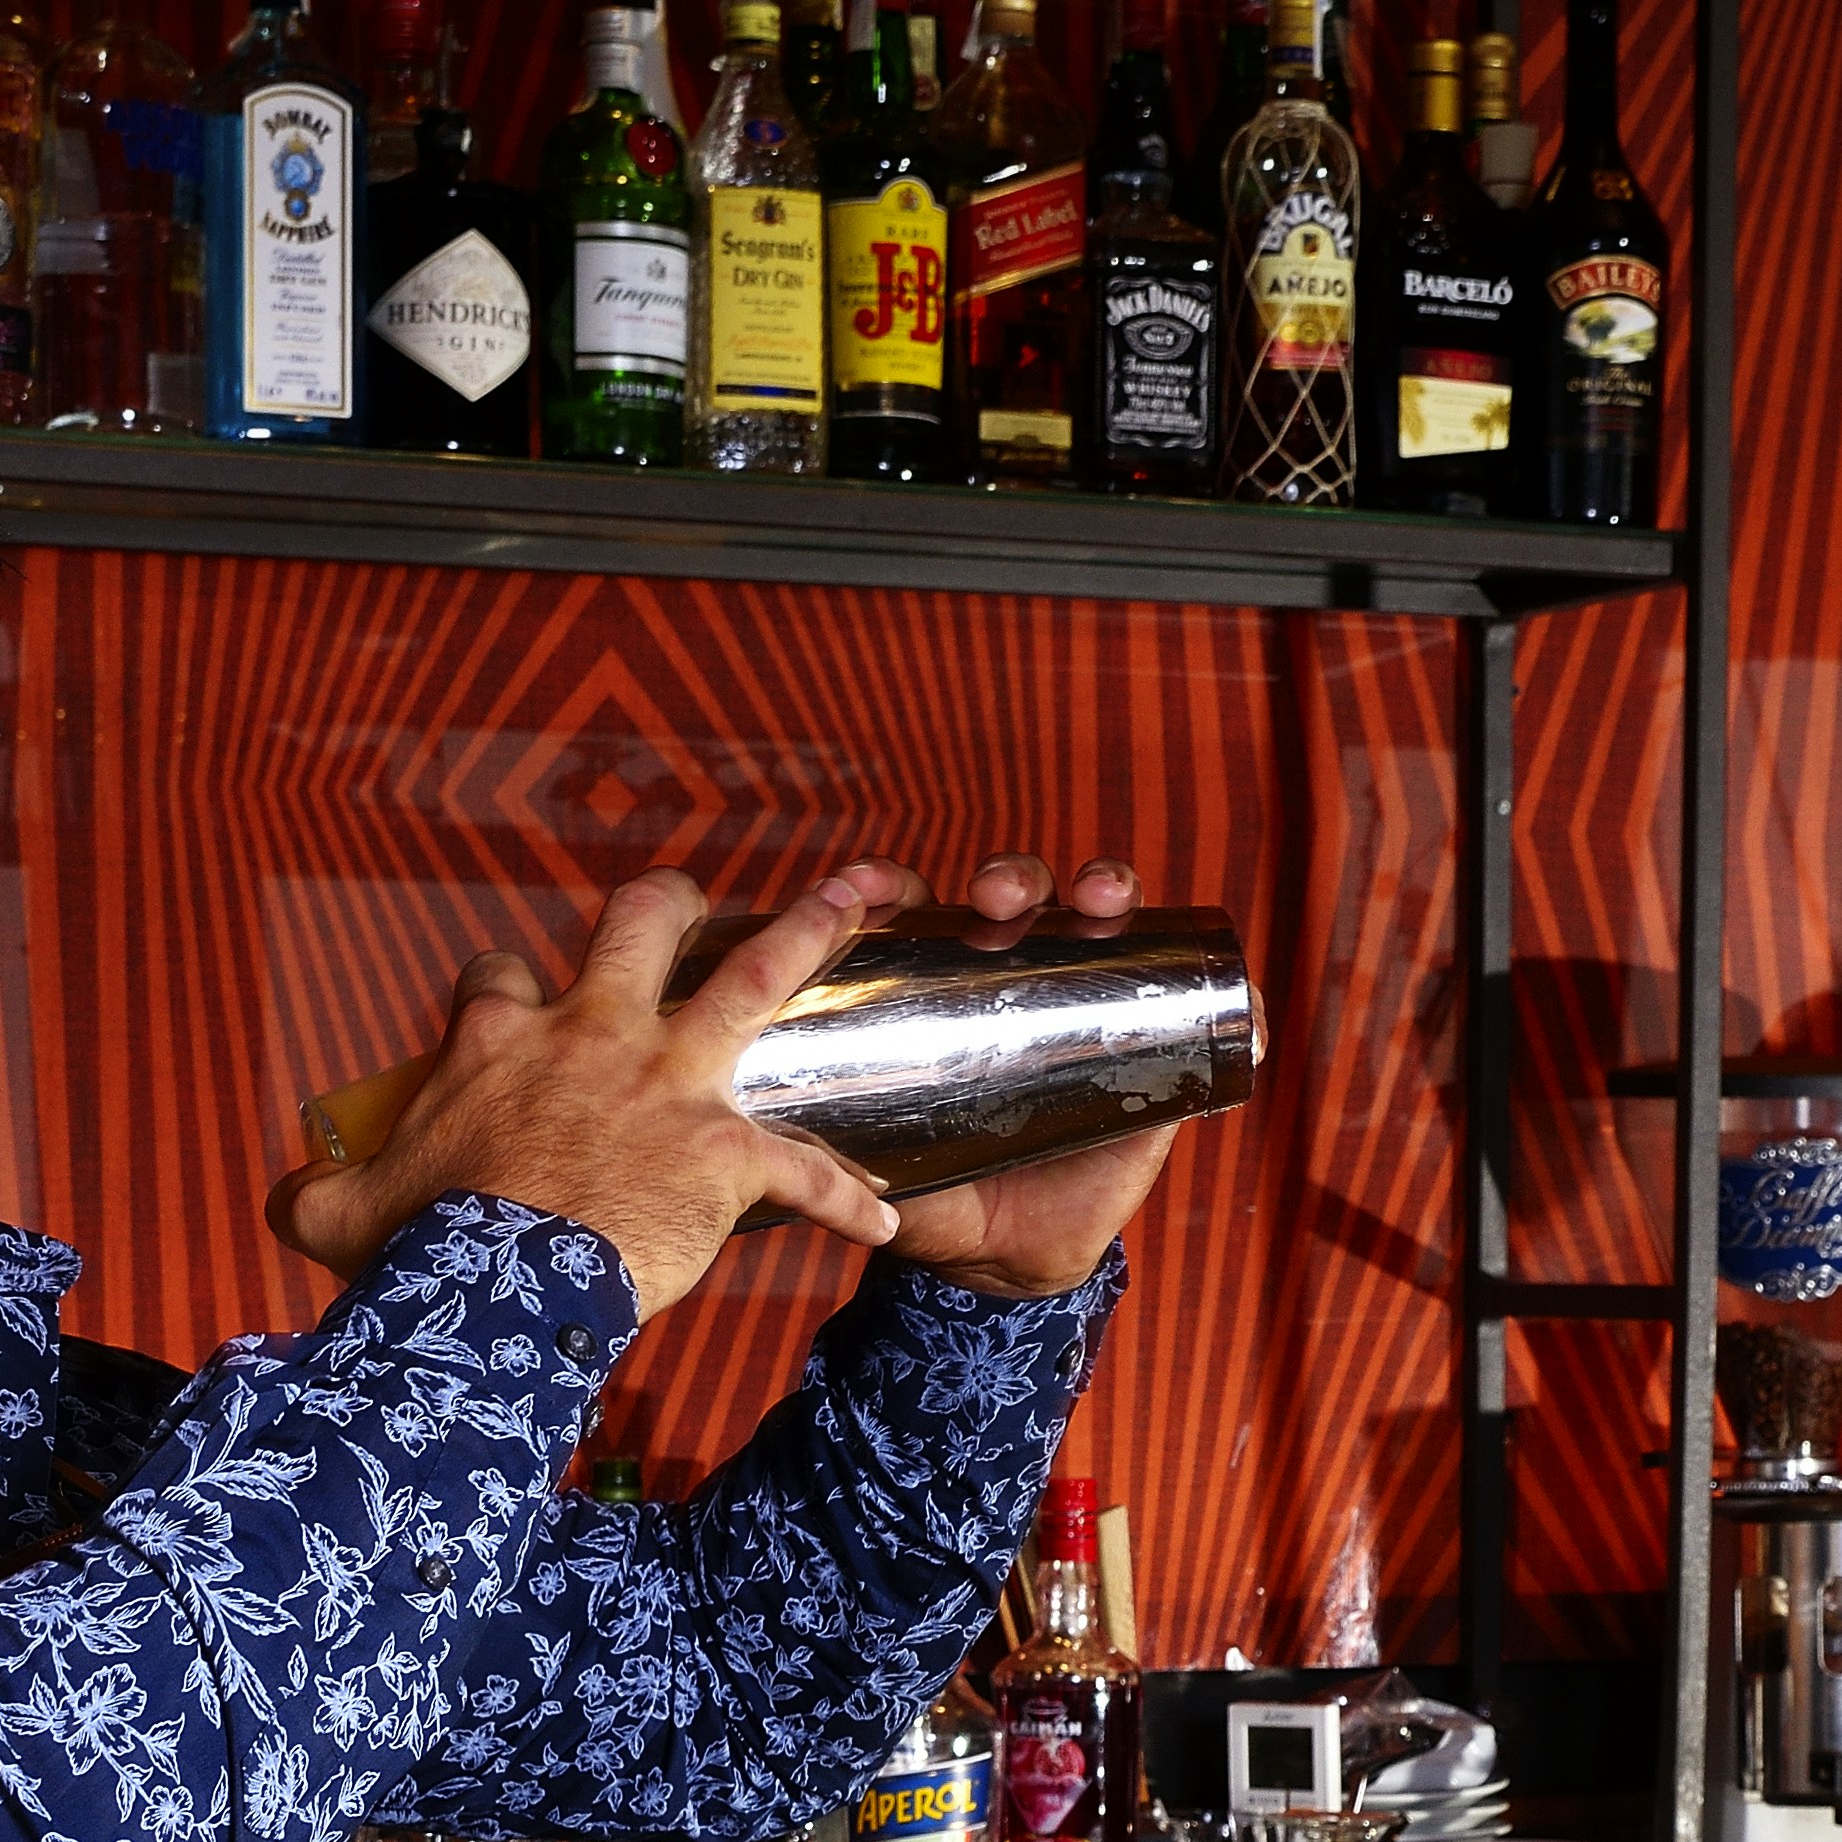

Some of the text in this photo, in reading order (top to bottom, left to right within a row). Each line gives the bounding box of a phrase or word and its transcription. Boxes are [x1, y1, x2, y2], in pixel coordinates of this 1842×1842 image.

[263, 109, 332, 145] BOMBAY
[974, 218, 1020, 250] Red
[1021, 199, 1078, 235] Label
[721, 230, 814, 262] Seagram's
[732, 267, 804, 289] DRY GIN
[853, 241, 942, 344] J&B
[1403, 270, 1513, 304] BARCELÓ
[387, 302, 530, 331] HENDRICK
[857, 1778, 977, 1834] APEROL
